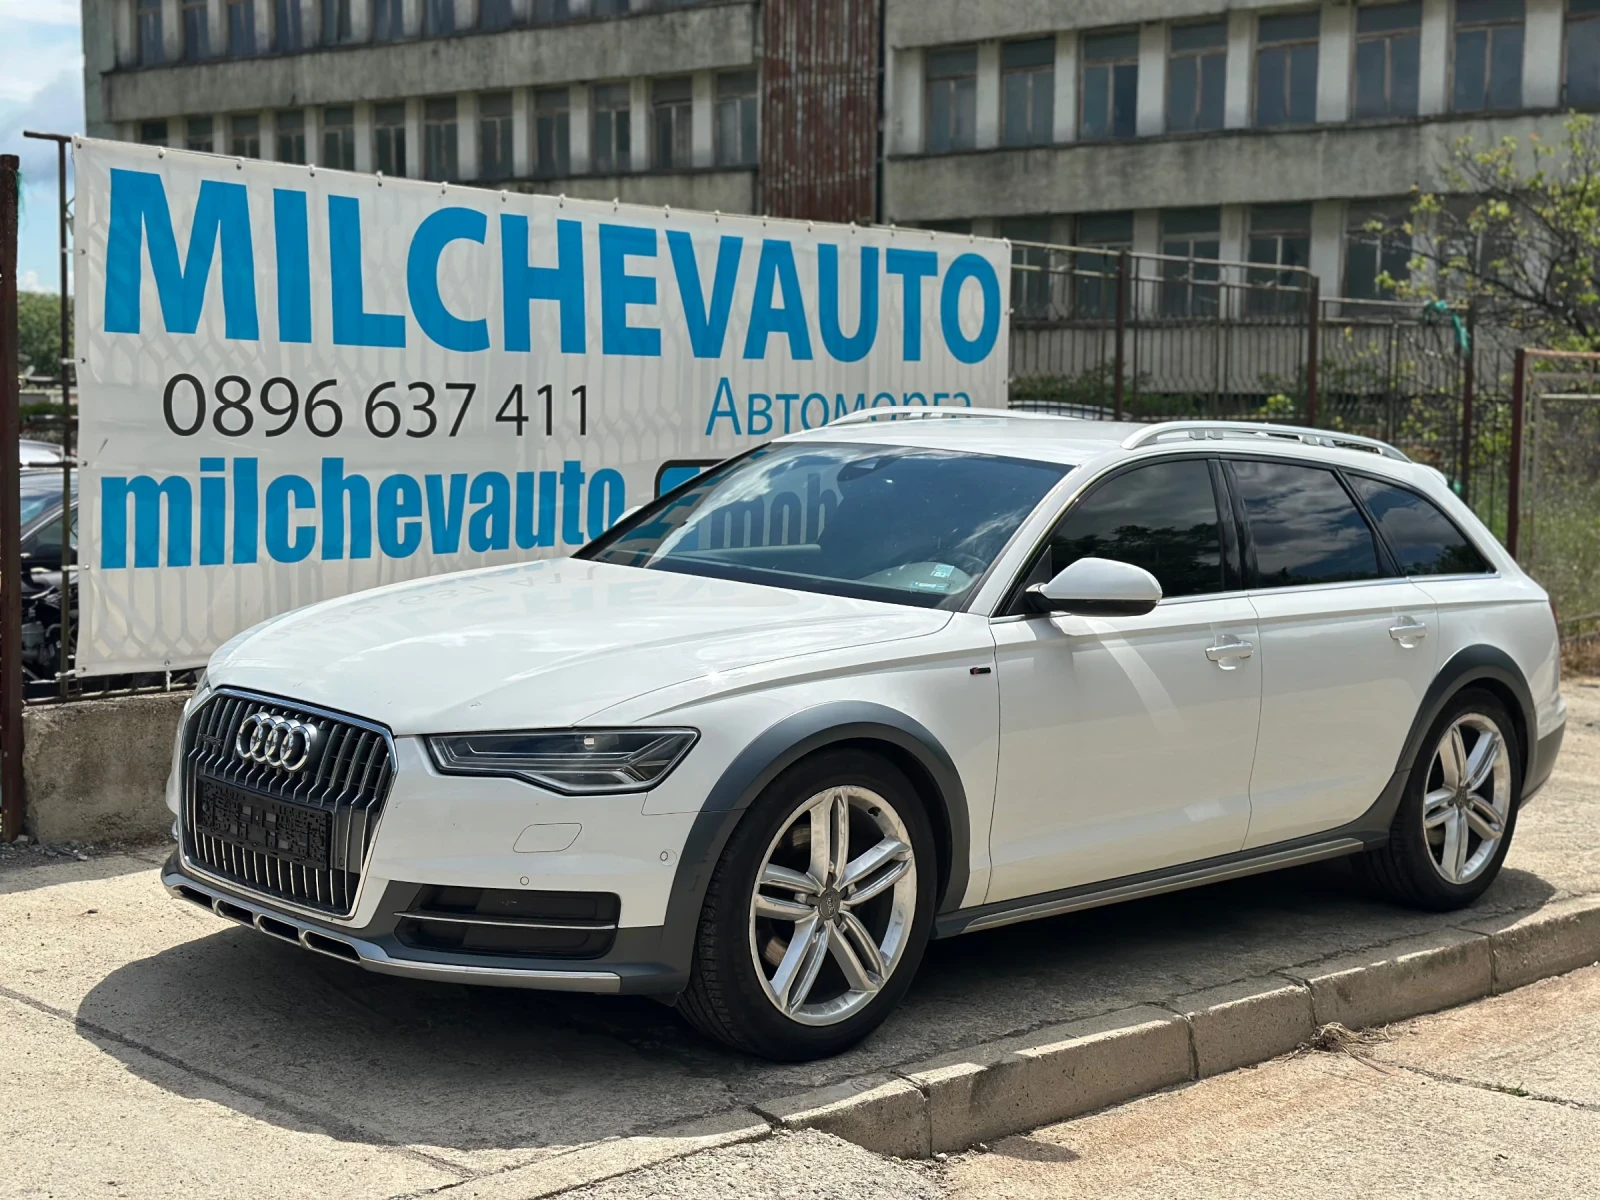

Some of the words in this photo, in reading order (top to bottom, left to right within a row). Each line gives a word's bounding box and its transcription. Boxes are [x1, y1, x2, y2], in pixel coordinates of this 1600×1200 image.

[105, 168, 1001, 364] MILCHEVAUTO
[163, 373, 342, 438] 0896
[365, 381, 476, 438] 637
[495, 384, 587, 436] 411
[101, 457, 626, 569] milchevauto
